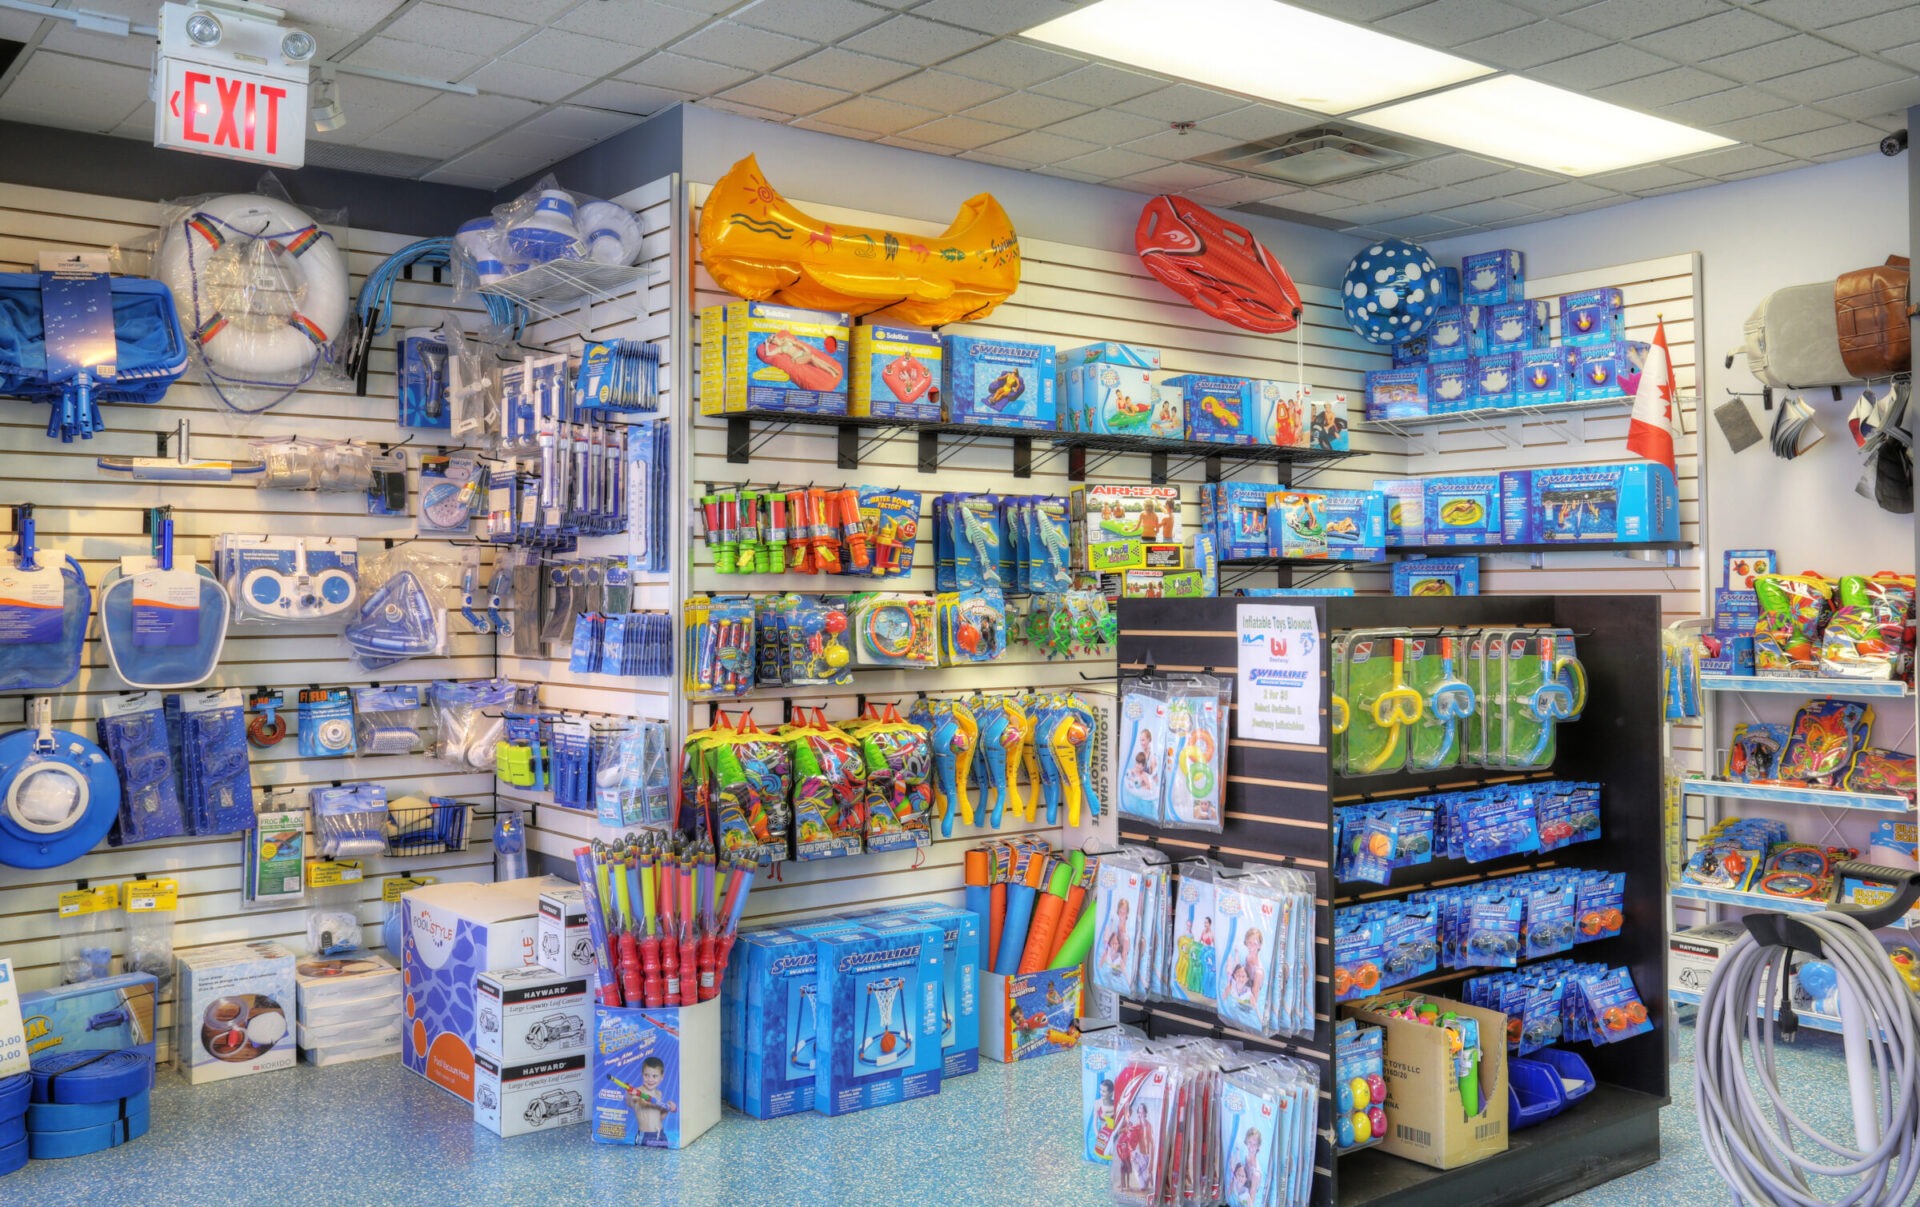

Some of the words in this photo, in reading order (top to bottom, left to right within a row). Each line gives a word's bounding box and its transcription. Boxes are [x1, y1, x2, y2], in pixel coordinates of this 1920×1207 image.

[183, 70, 287, 155] EXIT
[970, 343, 1040, 358] SWIMLINE
[1538, 471, 1619, 488] SWIMLINE
[1091, 485, 1177, 498] AIRHEAD
[1242, 616, 1272, 629] Inflatable
[1272, 616, 1286, 632] Toys
[1287, 616, 1312, 630] Blowout
[1248, 668, 1308, 681] SWIMLINE
[1100, 707, 1109, 773] FLOATING
[1091, 755, 1100, 827] FLOTTTE
[1100, 777, 1109, 816] CHAIR
[771, 953, 817, 974] SWIM
[839, 945, 920, 971] SWIMLINE
[524, 987, 566, 999] HAYWARD
[510, 1004, 525, 1013] Large
[526, 1001, 548, 1012] Capacity
[549, 998, 559, 1007] Leaf
[560, 996, 583, 1005] Canister
[261, 1058, 292, 1070] KOKIDO
[523, 1062, 565, 1075] HAYWARD
[1389, 1060, 1408, 1072] TOYS
[1407, 1066, 1421, 1074] LLC
[508, 1081, 523, 1090] Large
[525, 1077, 546, 1088] Capacity
[548, 1074, 557, 1084] Leaf
[558, 1072, 582, 1082] Canister
